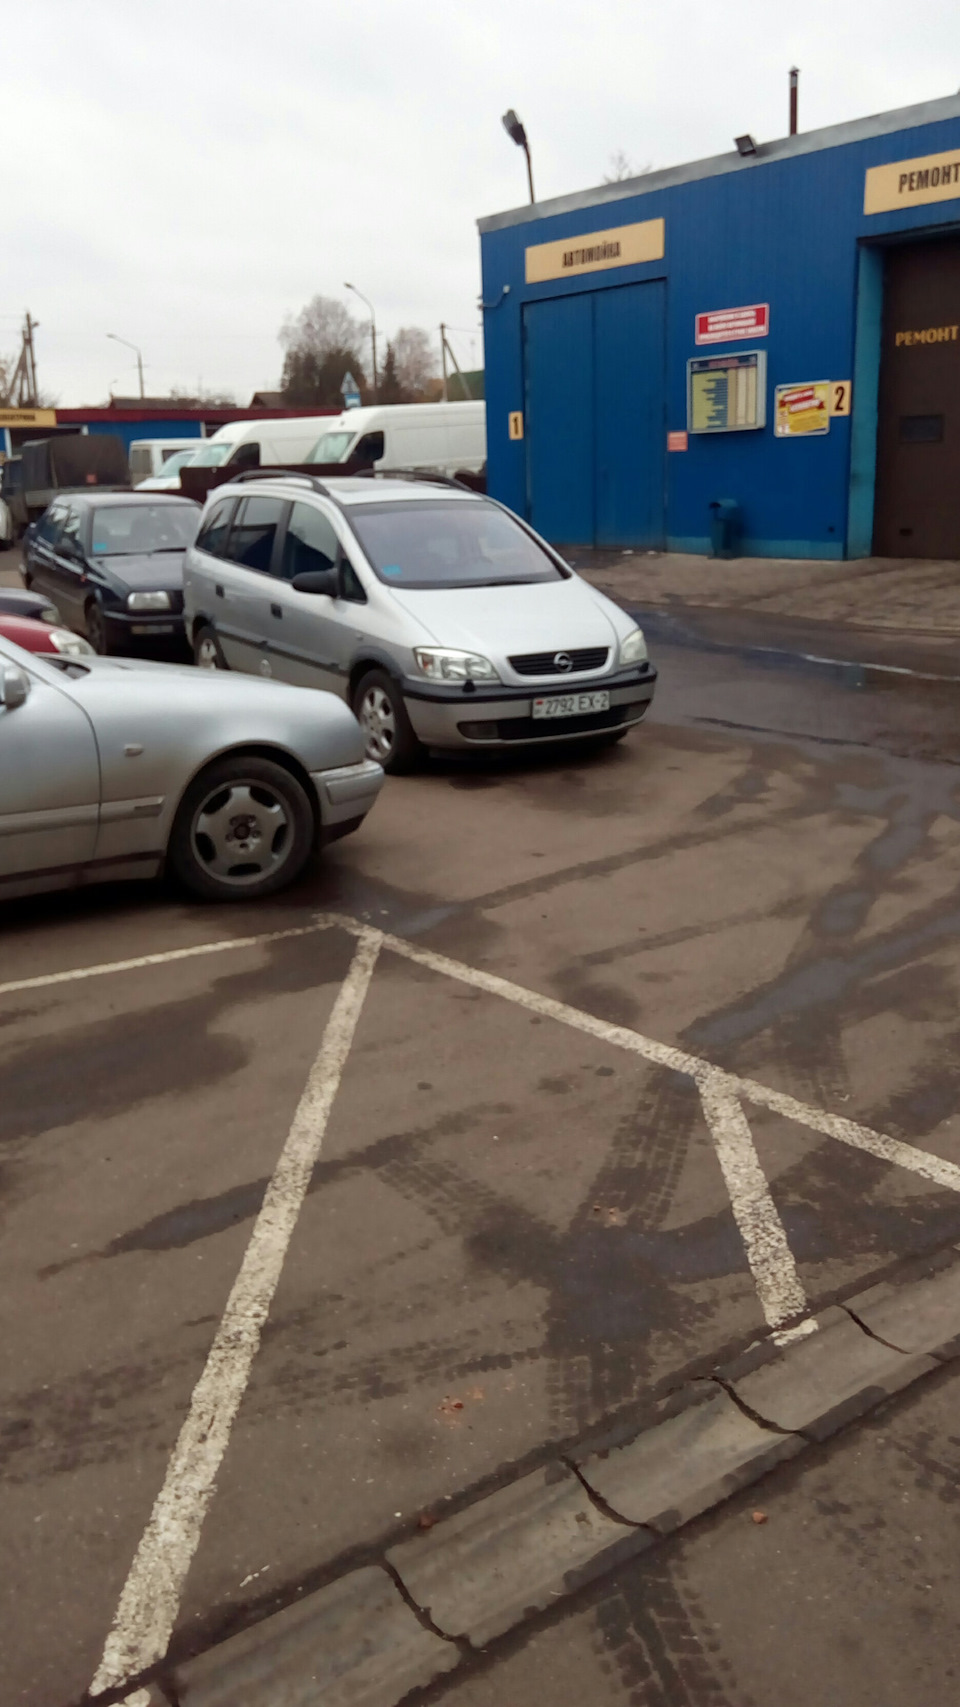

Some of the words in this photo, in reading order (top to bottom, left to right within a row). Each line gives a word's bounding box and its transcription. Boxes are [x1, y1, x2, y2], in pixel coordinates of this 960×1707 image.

[898, 162, 960, 194] РЕМОНТ
[562, 241, 621, 268] АВТОМОЙКА
[895, 325, 959, 347] РЕМОНТ
[834, 386, 845, 411] 2
[513, 416, 519, 435] 1
[545, 697, 575, 715] 2792
